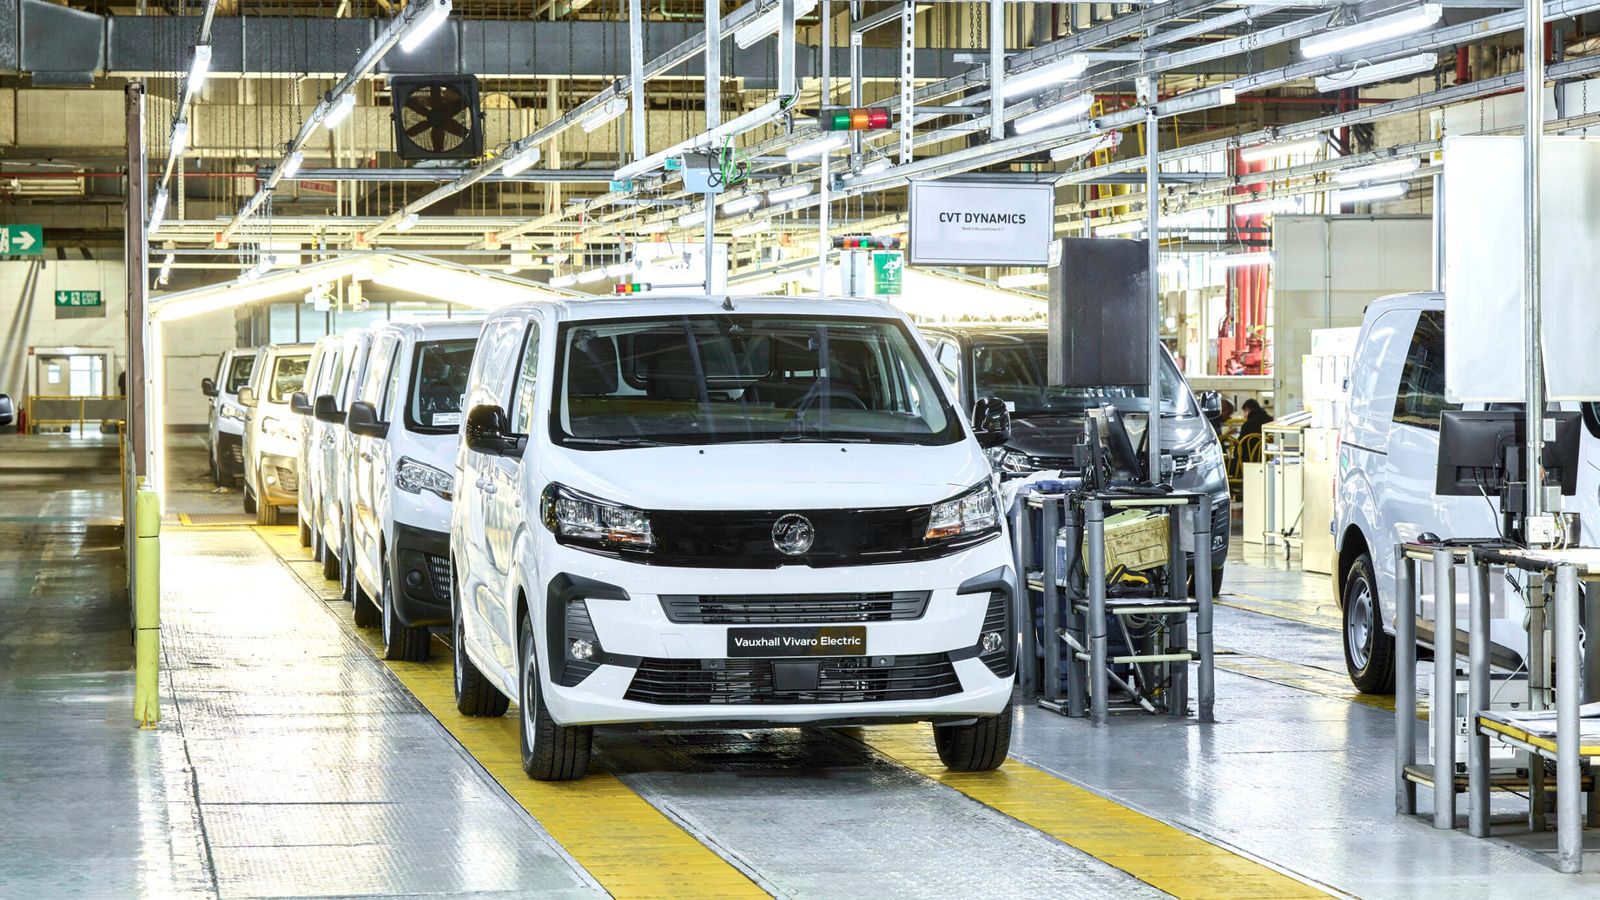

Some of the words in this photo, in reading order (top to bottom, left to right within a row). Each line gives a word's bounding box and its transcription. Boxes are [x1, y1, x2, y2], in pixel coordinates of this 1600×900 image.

[939, 212, 962, 223] CVT
[964, 213, 1026, 224] DYNAMICS
[734, 637, 780, 647] Vauxhall
[783, 636, 818, 646] Vivaro
[820, 636, 861, 646] Electric
